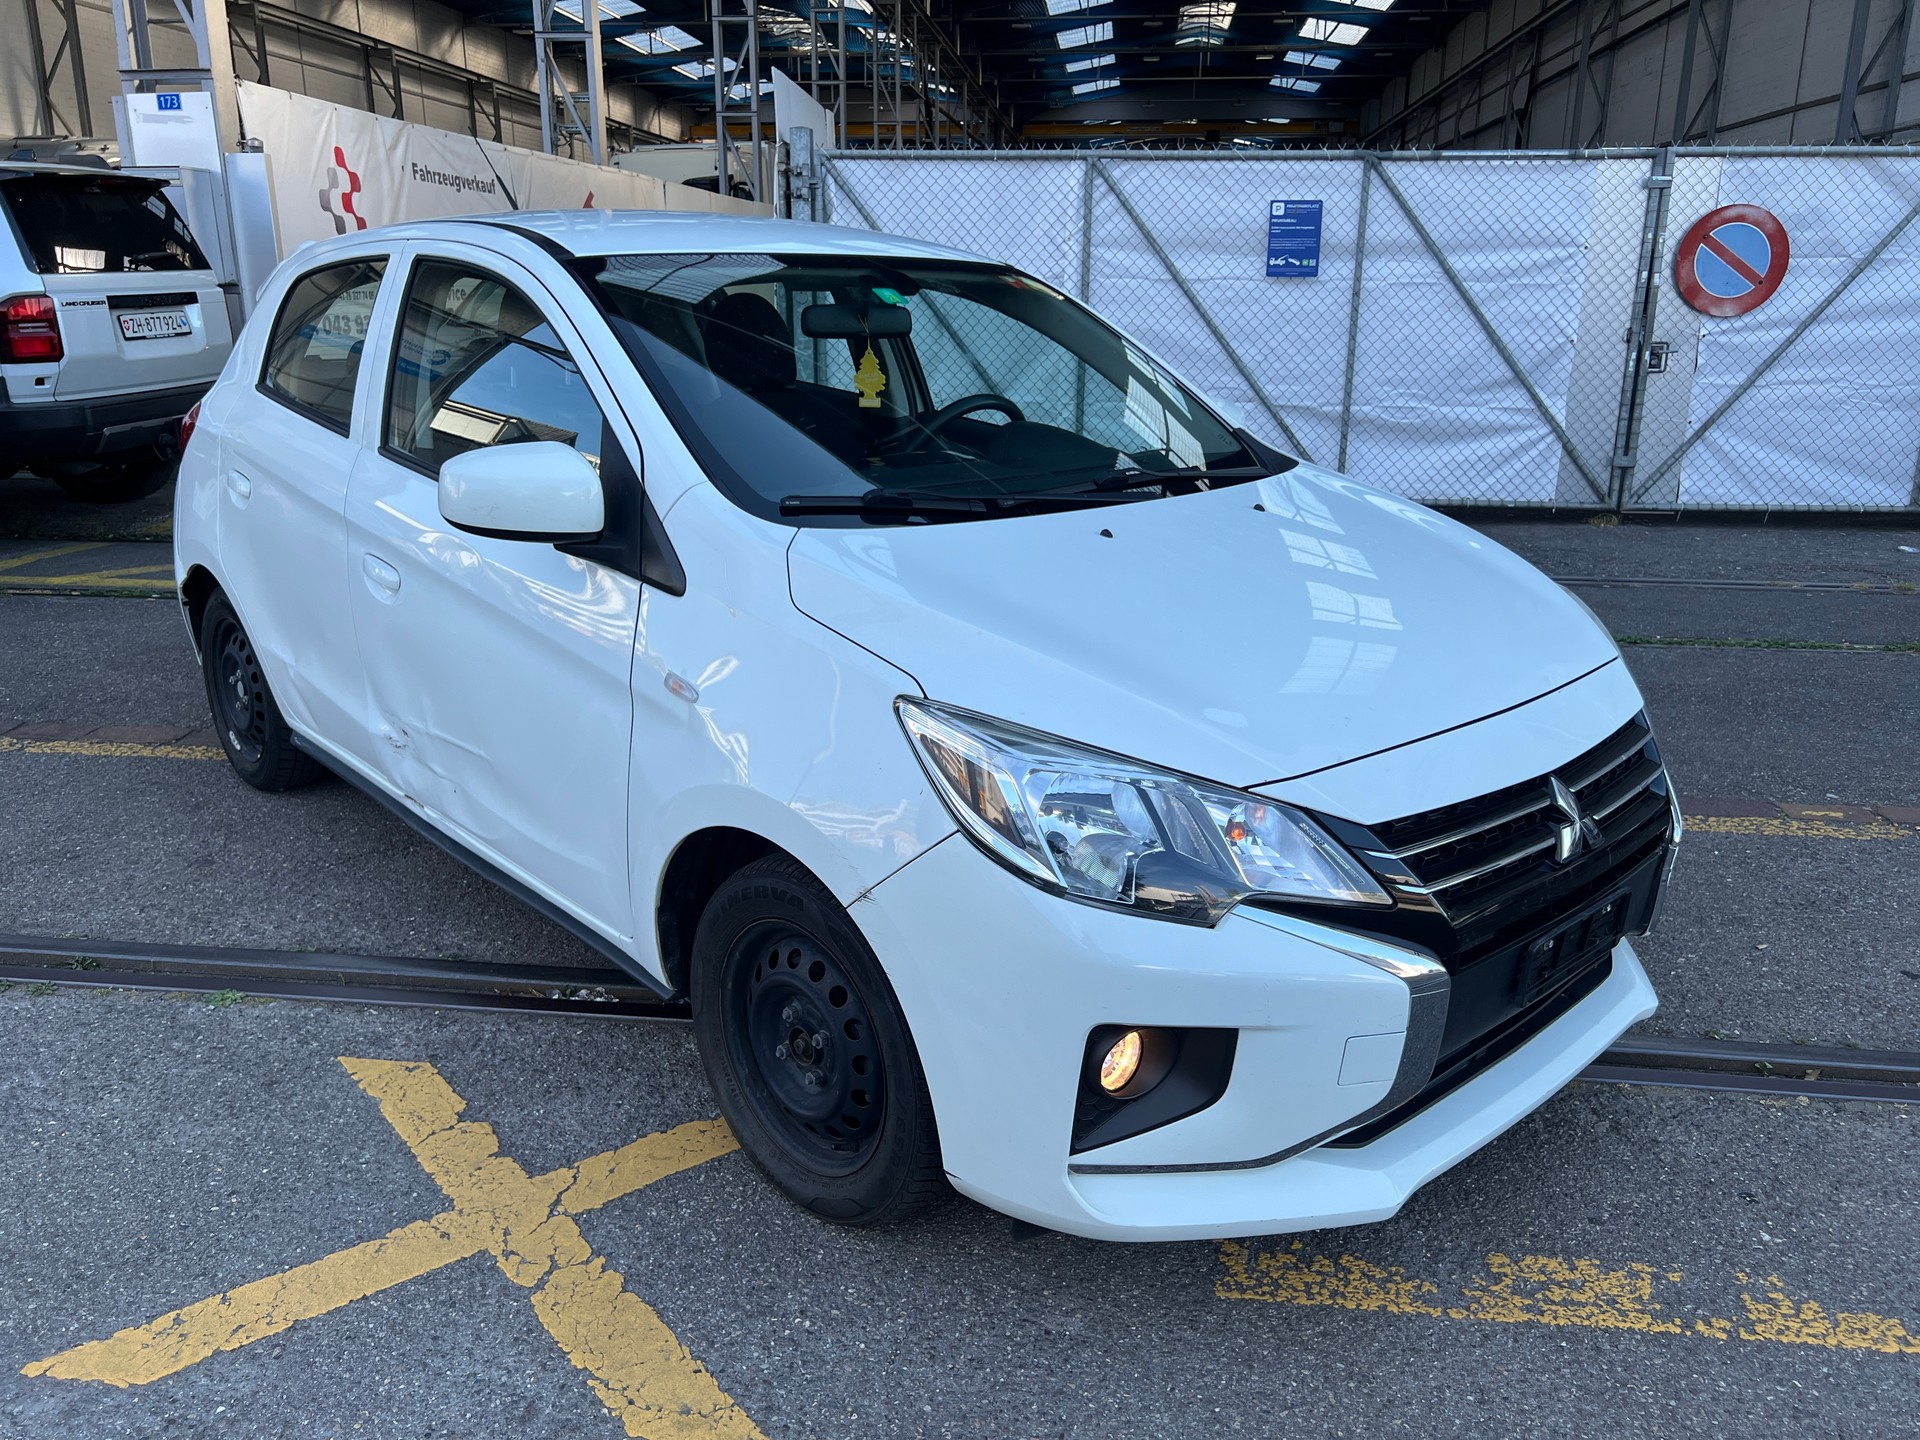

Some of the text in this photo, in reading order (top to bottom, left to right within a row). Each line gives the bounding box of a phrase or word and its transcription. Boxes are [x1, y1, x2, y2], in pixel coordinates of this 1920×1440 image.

[160, 96, 178, 109] 173
[411, 162, 496, 195] Fahrzeugverkauf
[1275, 205, 1282, 213] P
[322, 314, 352, 337] 043
[709, 885, 804, 930] INERVA
